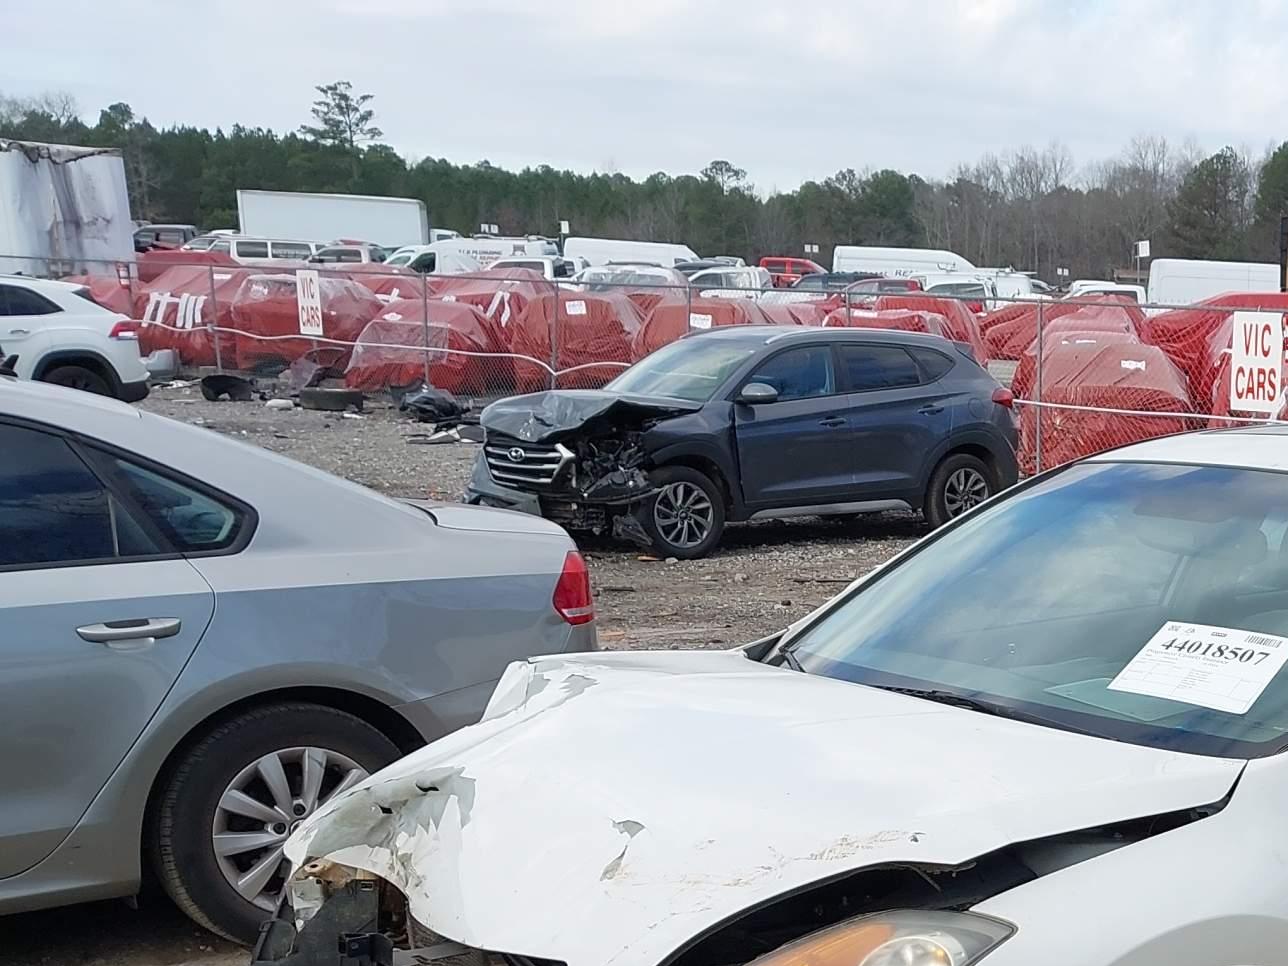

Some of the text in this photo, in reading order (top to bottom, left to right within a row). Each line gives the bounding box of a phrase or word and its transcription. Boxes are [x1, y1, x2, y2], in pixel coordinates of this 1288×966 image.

[301, 277, 315, 299] VIC
[301, 305, 320, 328] CARS
[1243, 323, 1272, 358] VIC
[1235, 366, 1277, 402] CARS
[1160, 638, 1271, 666] 44018507
